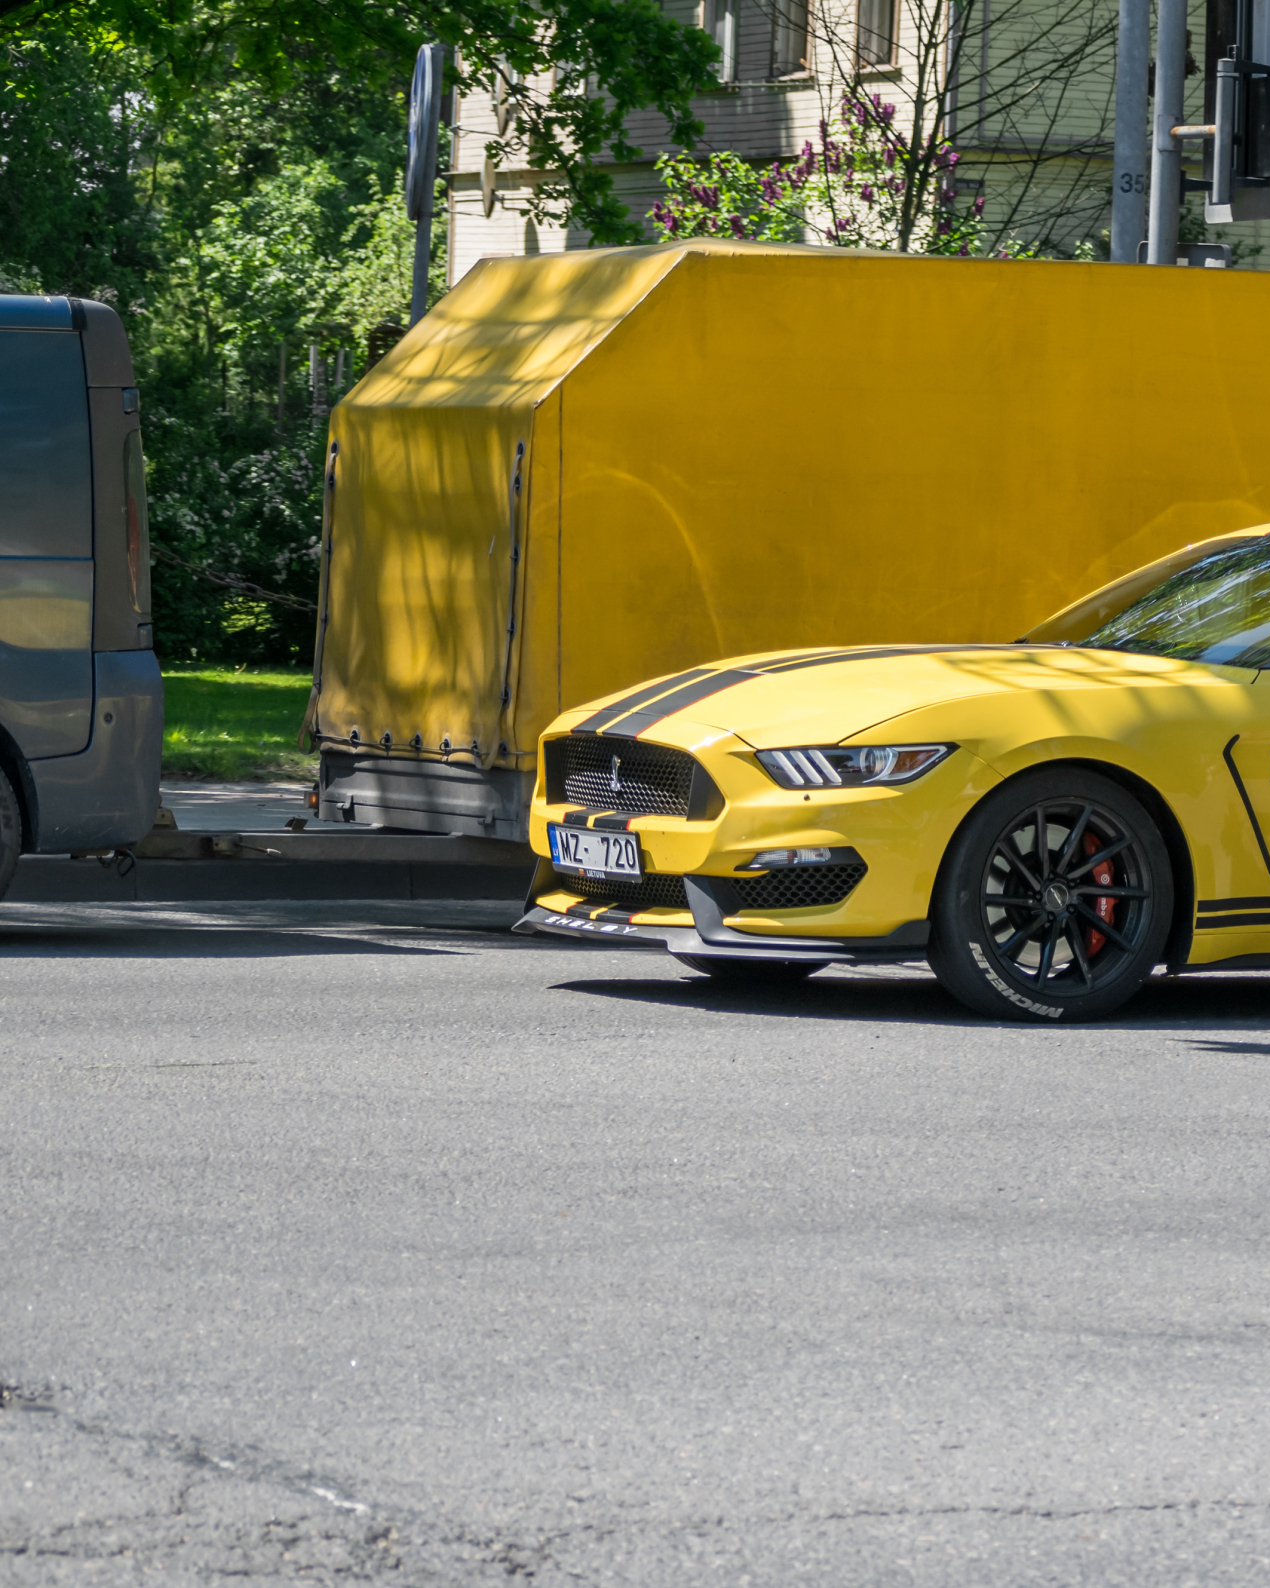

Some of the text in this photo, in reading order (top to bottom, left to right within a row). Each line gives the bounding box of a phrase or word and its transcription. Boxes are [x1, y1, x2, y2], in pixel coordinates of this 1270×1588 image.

[1120, 172, 1145, 194] 35
[586, 869, 606, 879] LIETUVA
[544, 916, 638, 934] SHELBY
[968, 941, 1064, 1018] MICHELIN
